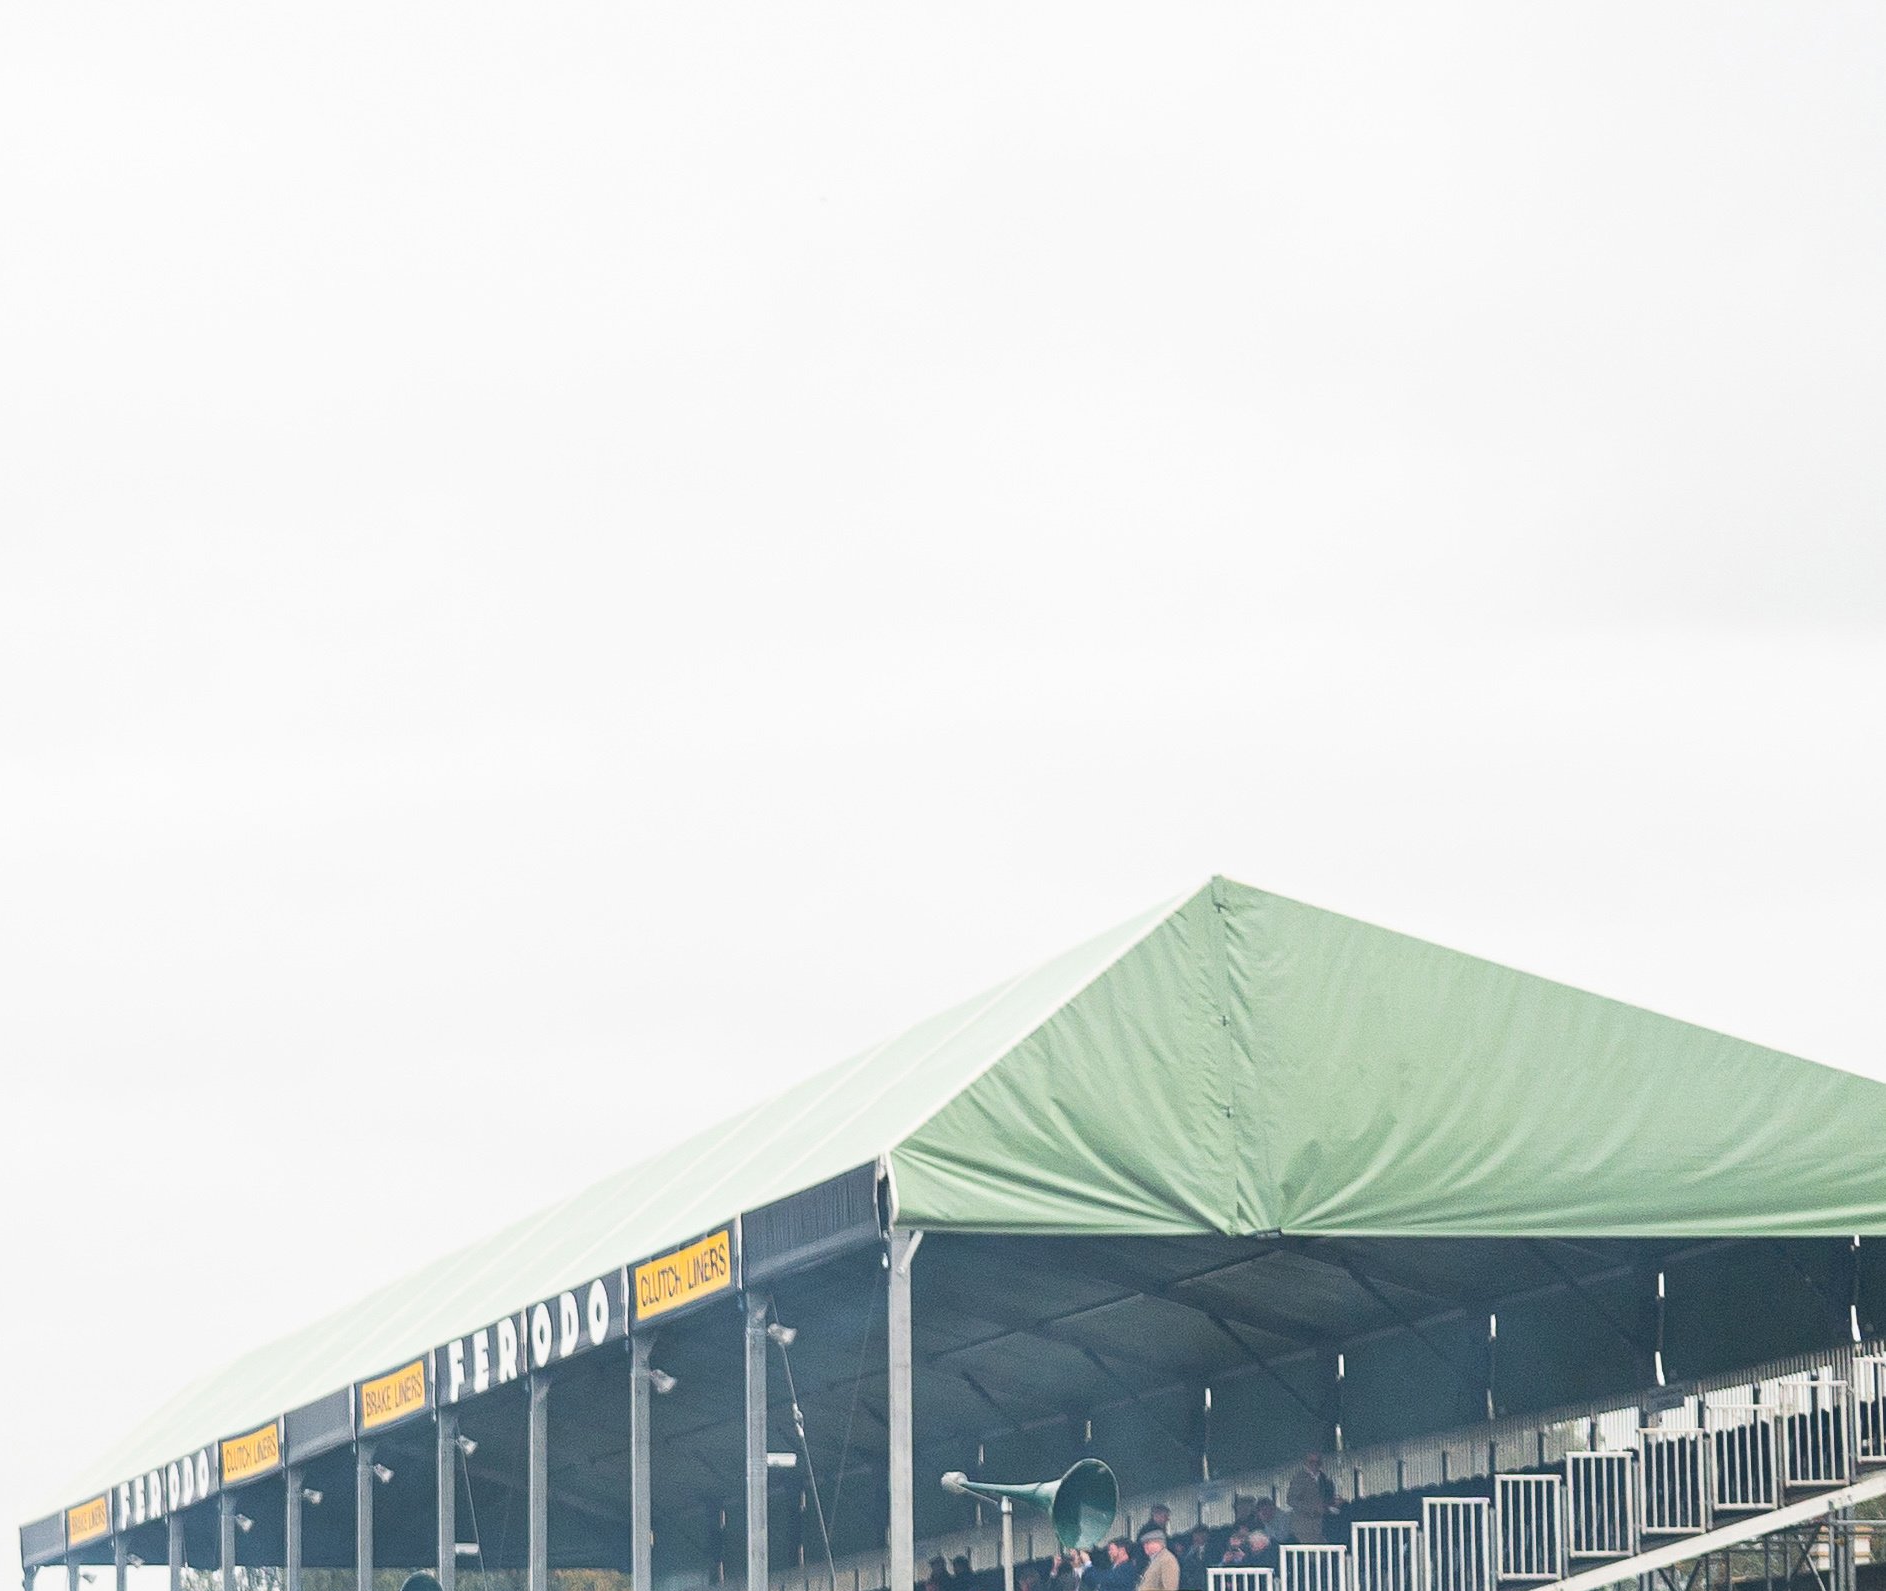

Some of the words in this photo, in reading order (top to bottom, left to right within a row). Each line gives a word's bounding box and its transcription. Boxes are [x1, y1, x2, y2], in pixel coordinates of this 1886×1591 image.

[640, 1266, 681, 1308] CLUTCH
[687, 1246, 727, 1290] LINERS
[447, 1277, 610, 1403] FERODO
[365, 1385, 392, 1418] BRAKE
[394, 1370, 424, 1404] LINERS
[118, 1448, 210, 1532] FERODO
